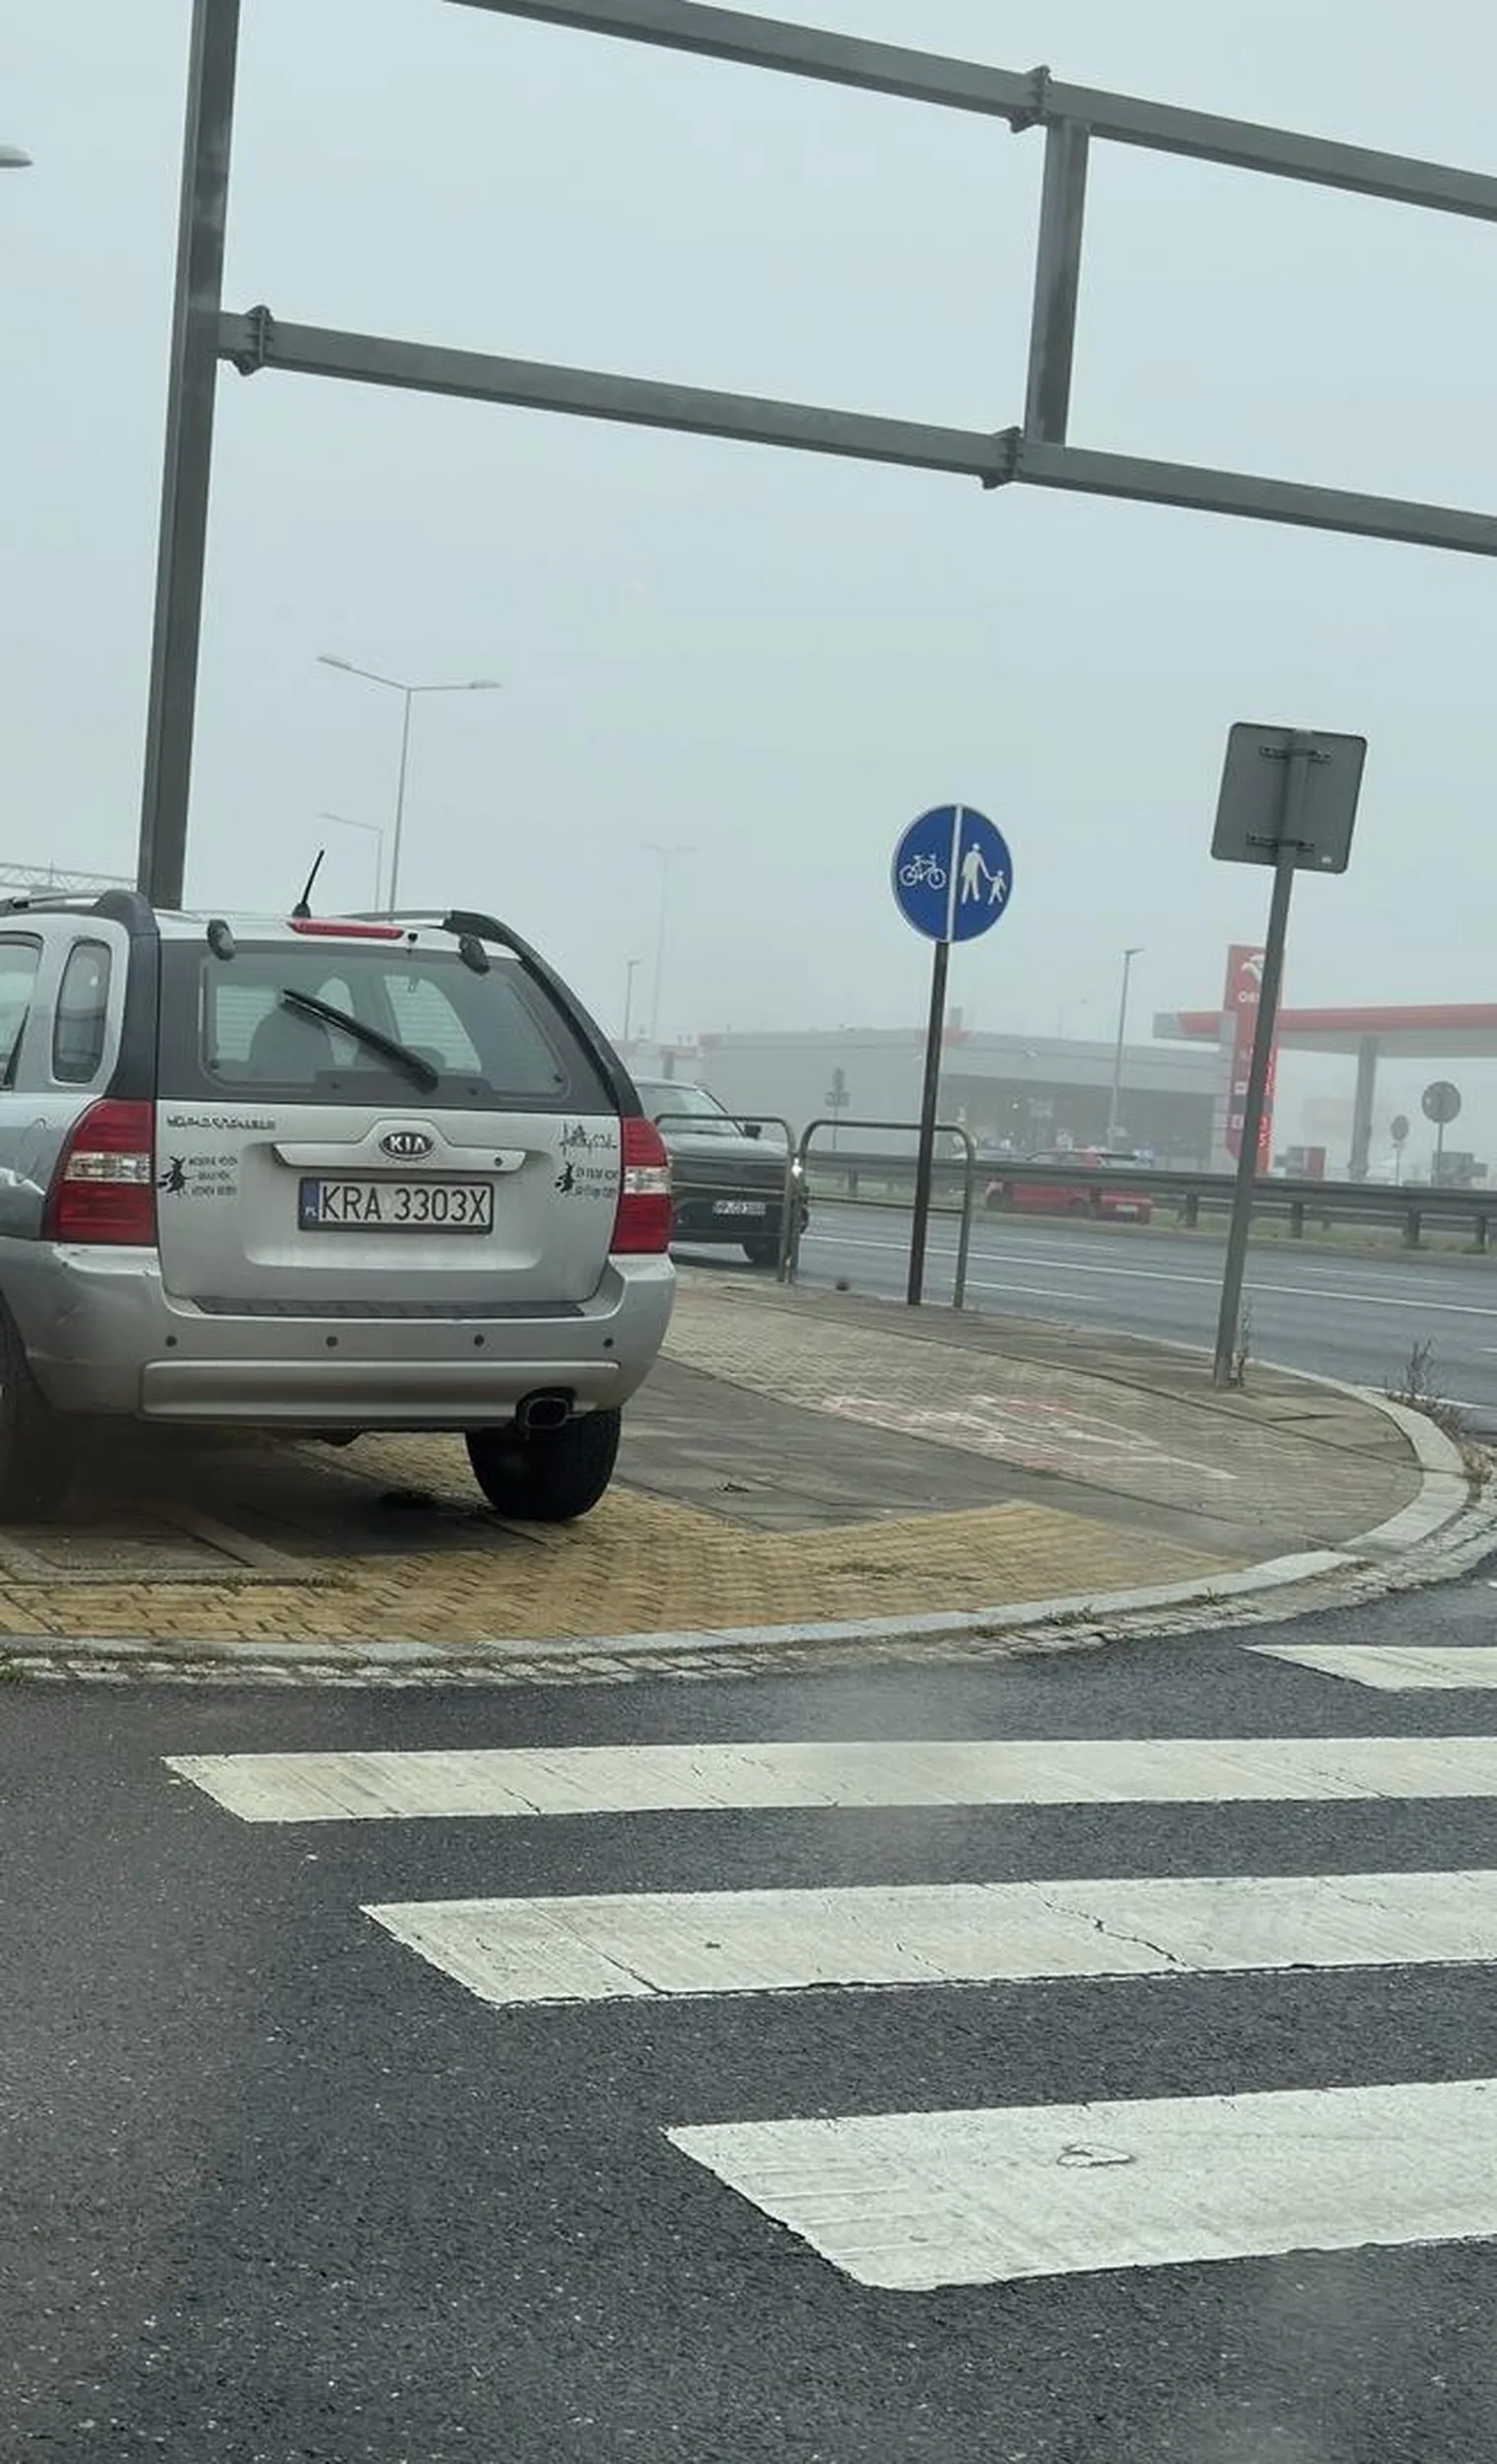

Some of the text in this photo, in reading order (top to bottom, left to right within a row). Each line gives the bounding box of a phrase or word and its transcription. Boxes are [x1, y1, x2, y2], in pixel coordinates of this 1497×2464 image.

[390, 1135, 426, 1151] KIA
[322, 1186, 487, 1223] KRA 3303X
